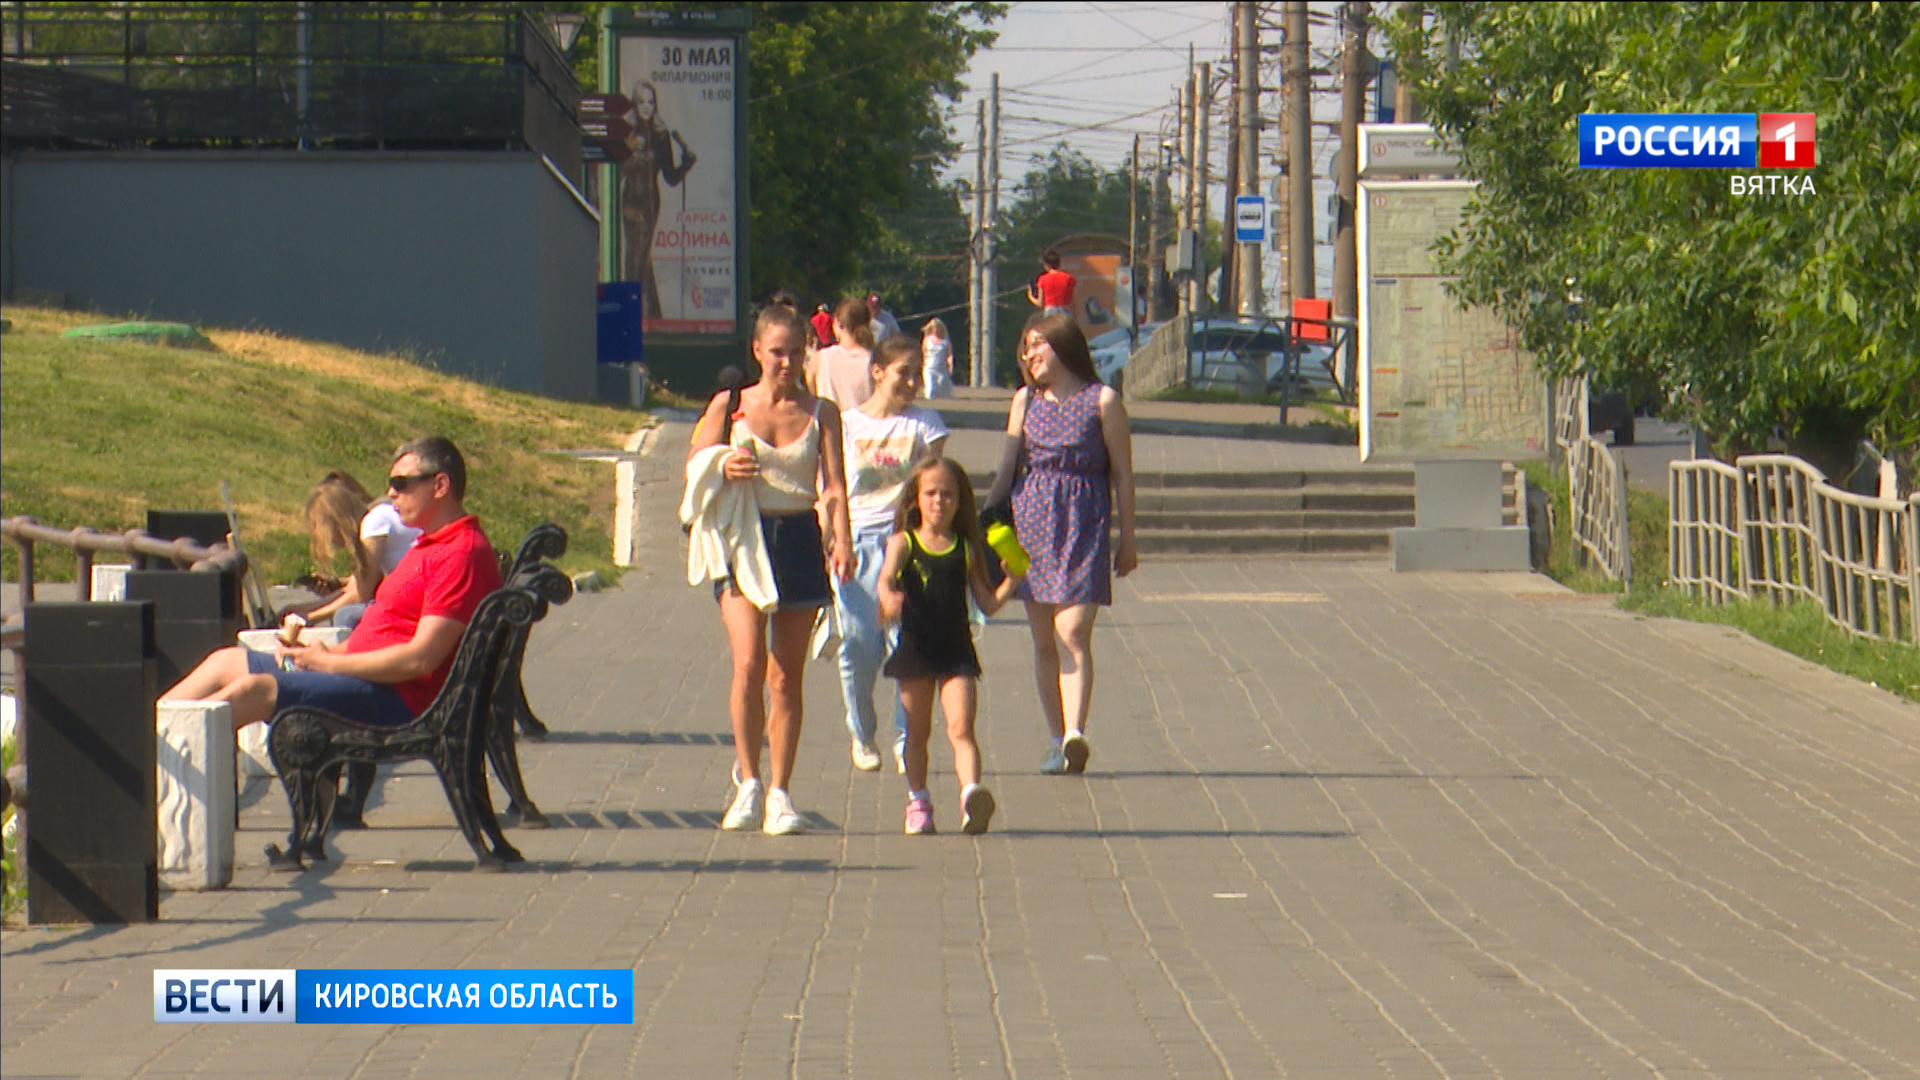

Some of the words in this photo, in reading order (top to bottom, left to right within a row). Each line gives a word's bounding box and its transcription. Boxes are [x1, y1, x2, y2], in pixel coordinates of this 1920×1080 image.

[662, 47, 682, 66] 30
[689, 47, 731, 66] МАЯ
[651, 71, 731, 83] ФИЛАРМОНИЯ
[676, 211, 727, 224] ЛАРИСА
[655, 230, 731, 248] ДОЛИНА
